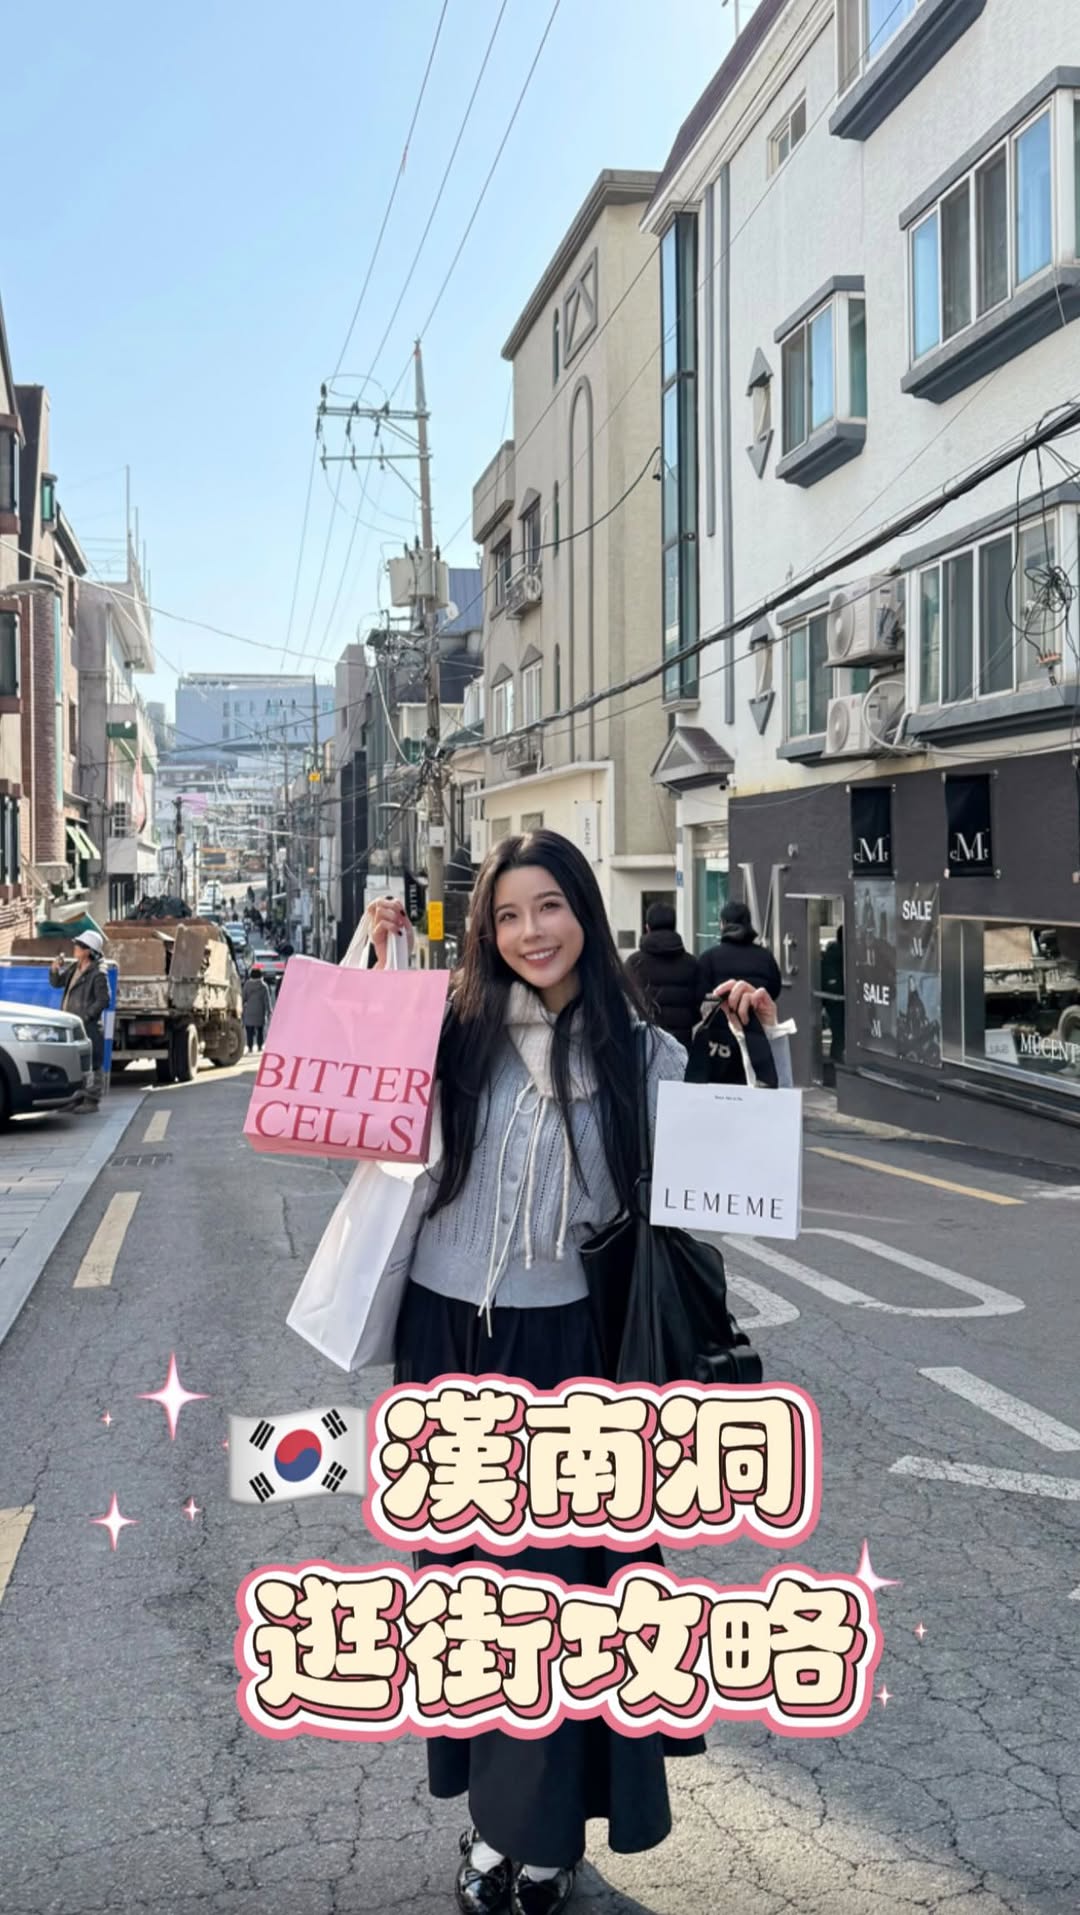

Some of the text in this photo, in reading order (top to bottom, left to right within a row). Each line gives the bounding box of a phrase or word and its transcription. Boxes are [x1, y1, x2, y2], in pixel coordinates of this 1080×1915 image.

[902, 900, 933, 921] SALE
[863, 982, 892, 1006] SALE
[256, 1052, 432, 1107] BITTER
[255, 1100, 414, 1154] CELLS
[664, 1188, 784, 1220] LEMEME
